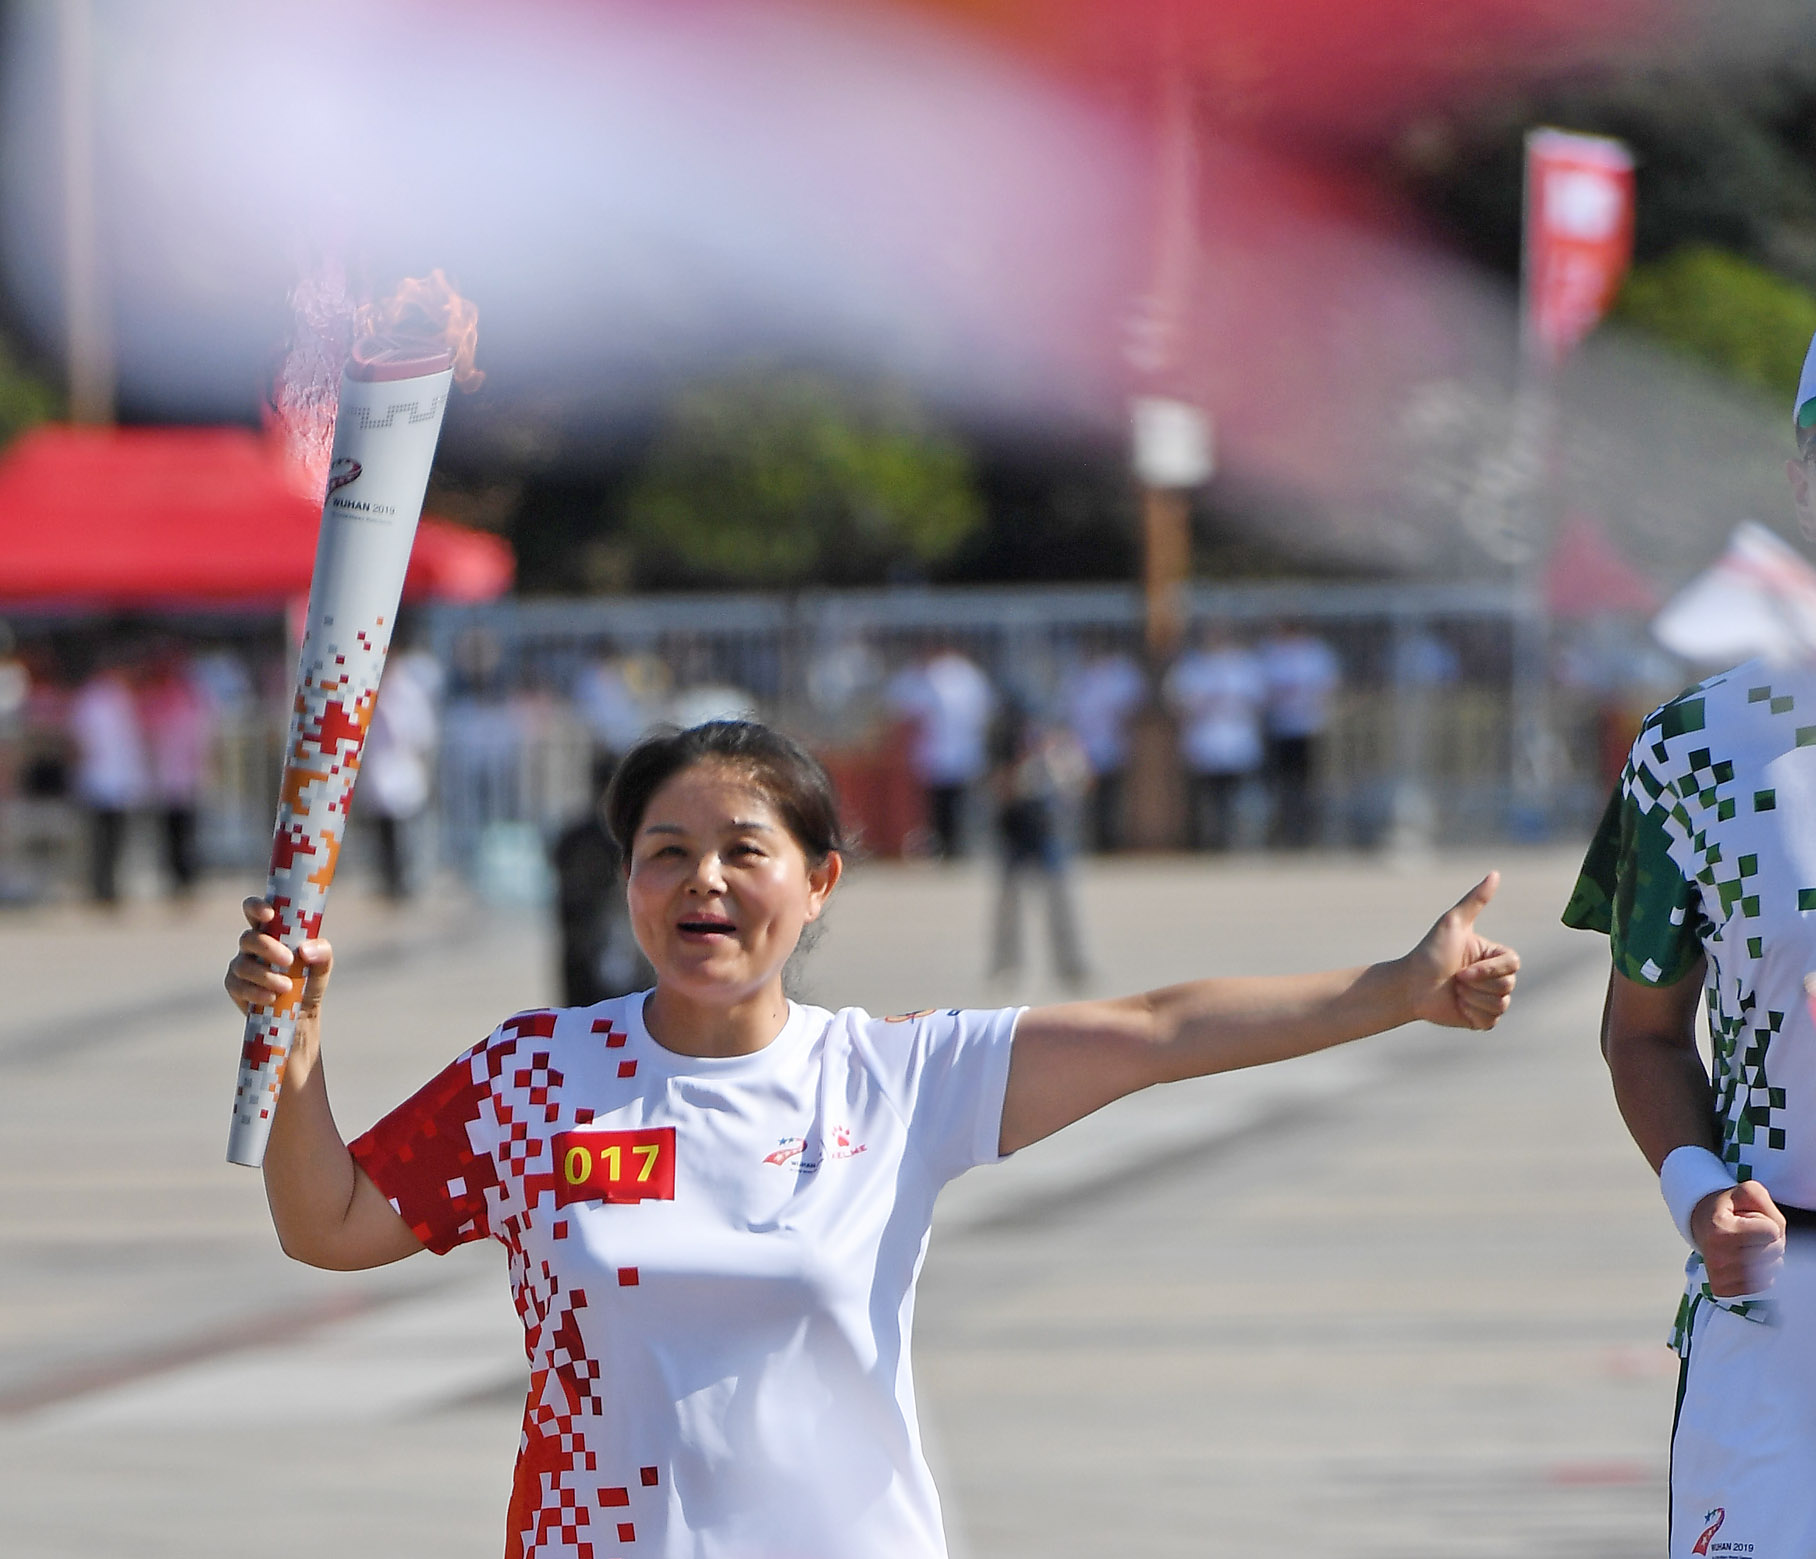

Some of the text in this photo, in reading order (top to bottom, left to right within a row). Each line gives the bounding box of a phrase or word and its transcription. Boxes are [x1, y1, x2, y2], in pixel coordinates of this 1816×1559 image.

[333, 498, 397, 515] WUHAN 2019
[564, 1144, 660, 1185] 017
[1733, 1542, 1755, 1552] 2019
